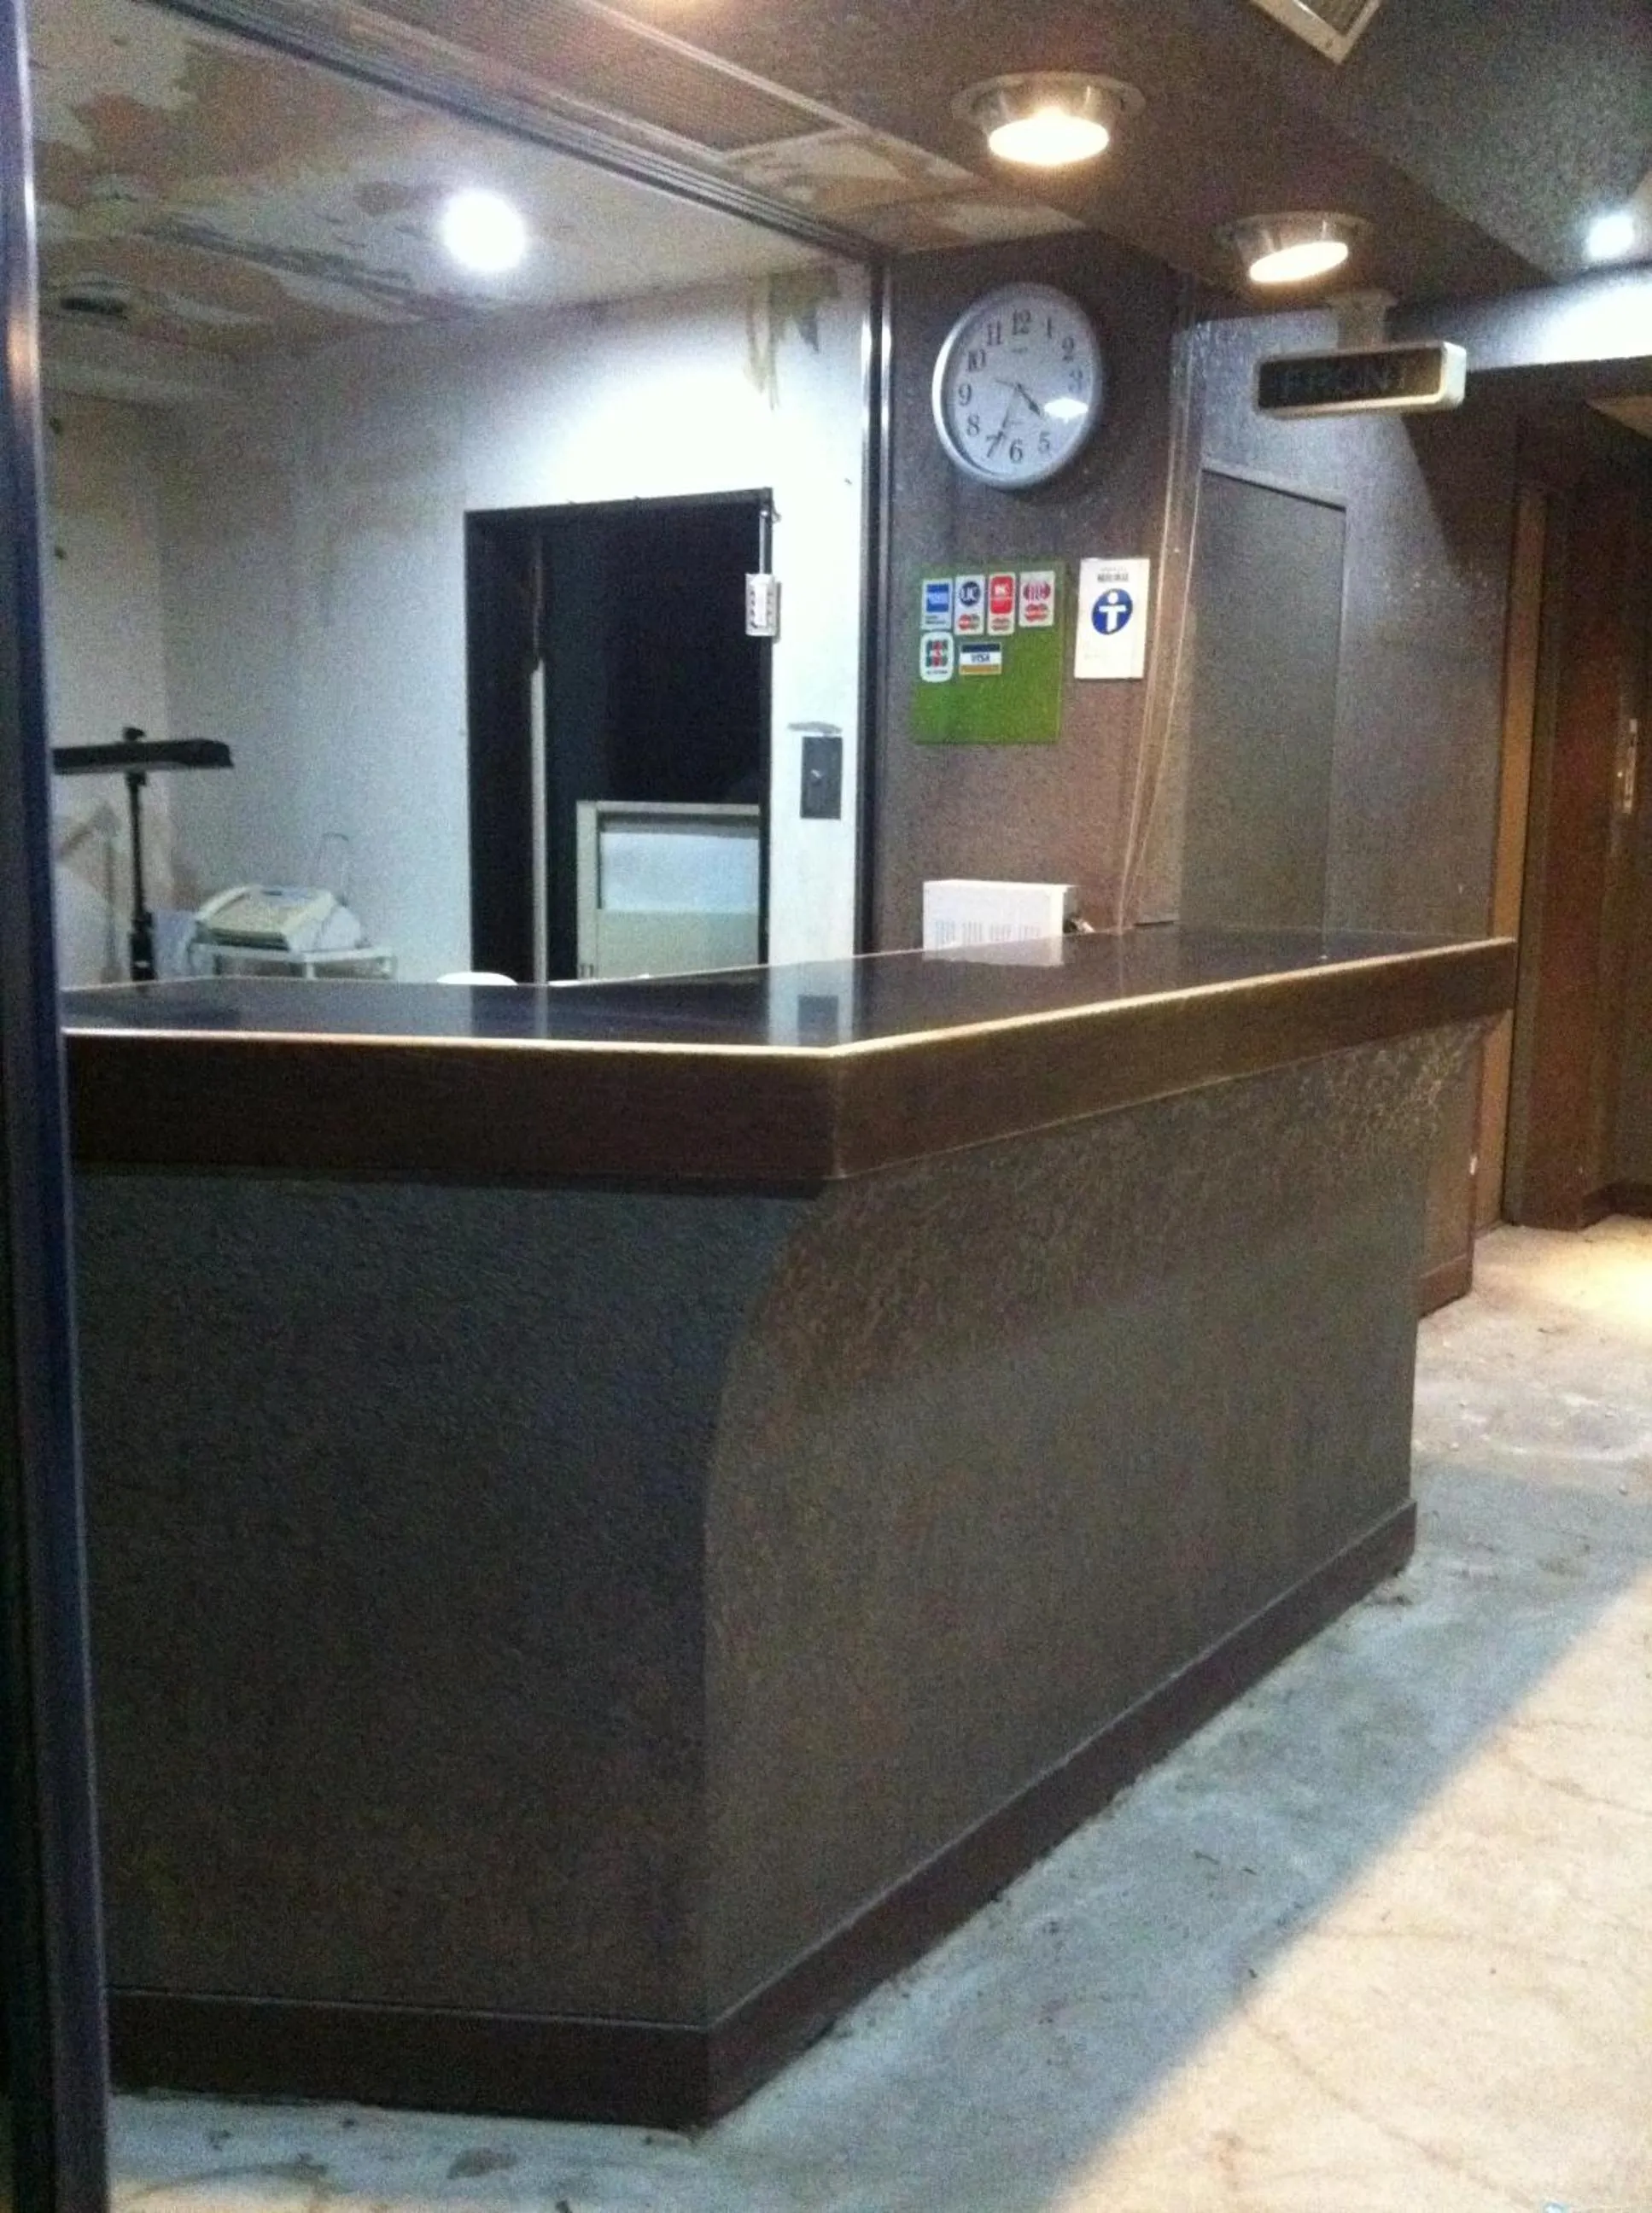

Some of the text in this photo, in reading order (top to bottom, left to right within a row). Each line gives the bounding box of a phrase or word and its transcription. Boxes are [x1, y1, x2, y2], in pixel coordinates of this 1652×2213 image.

[987, 321, 1002, 346] 11
[1011, 309, 1031, 336] 12
[1046, 316, 1053, 339] 1
[966, 348, 987, 373] 10
[1061, 336, 1075, 363] 2
[1069, 368, 1083, 393] 3
[958, 383, 972, 406] 9
[966, 414, 980, 437] 8
[985, 430, 1005, 458] 7
[1009, 438, 1024, 464] 6
[1037, 430, 1051, 454] 5
